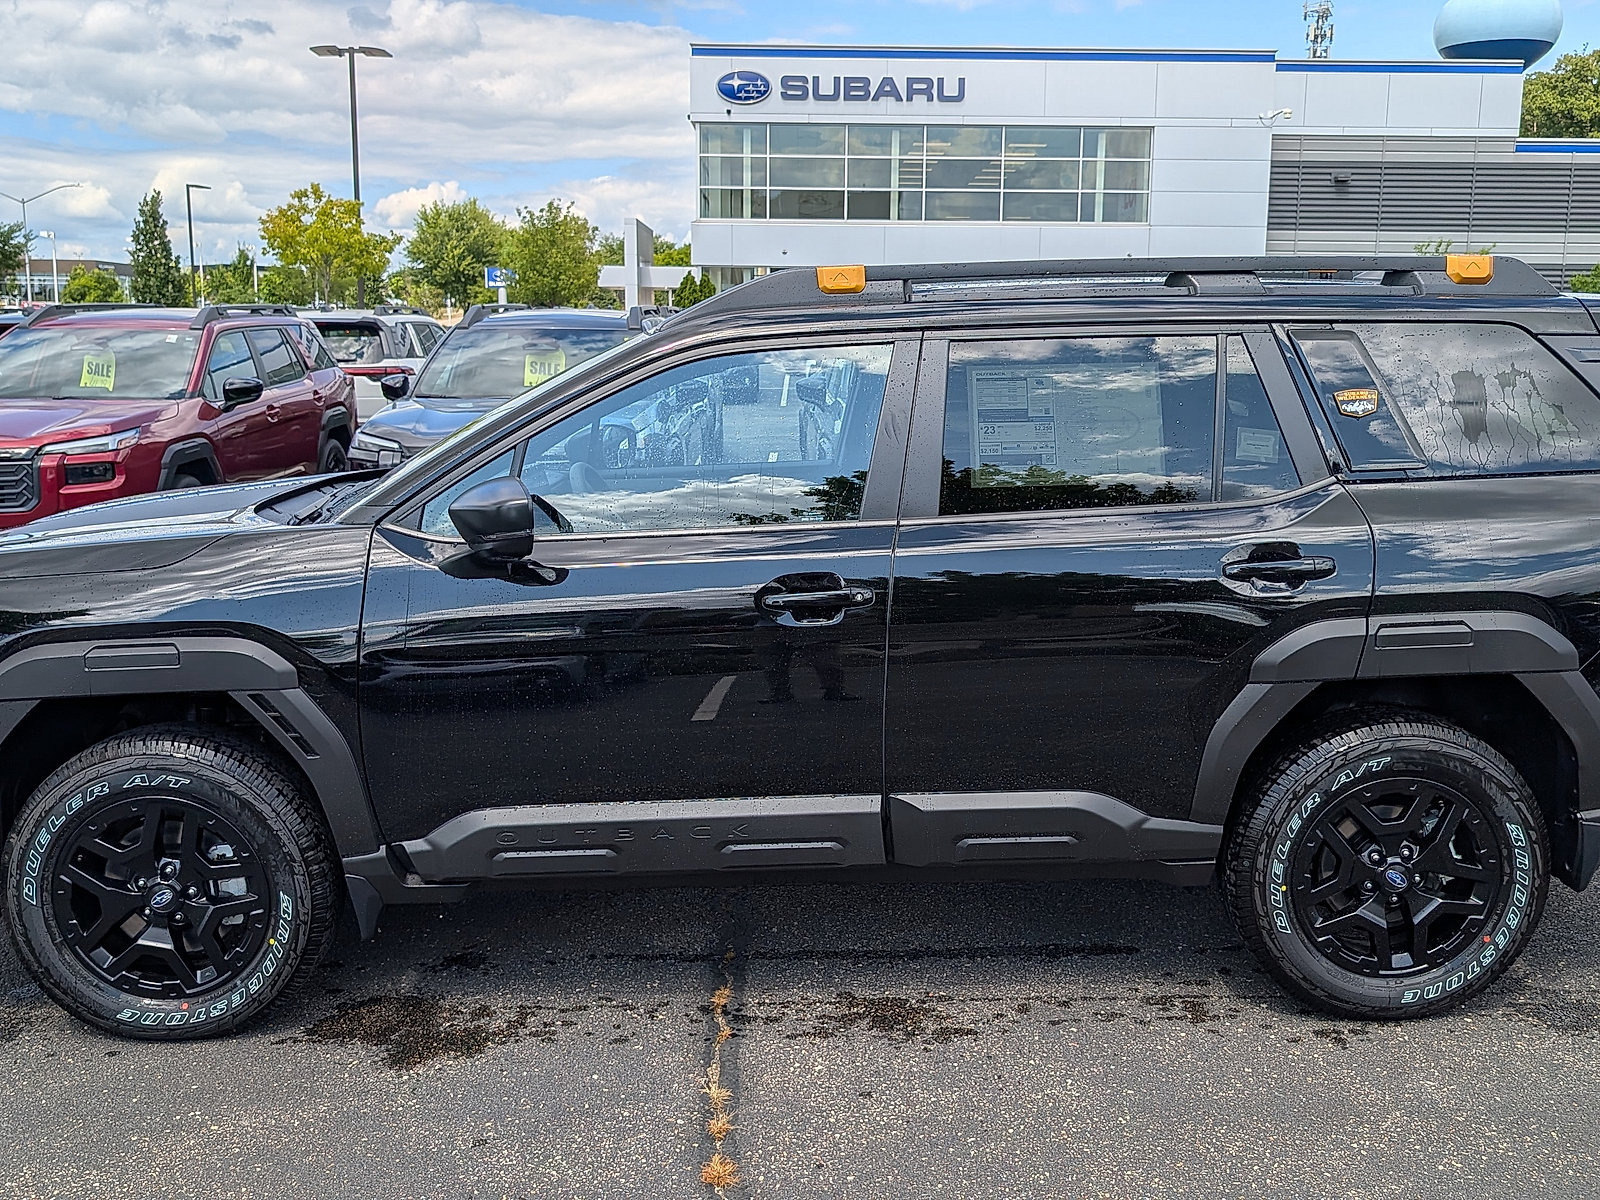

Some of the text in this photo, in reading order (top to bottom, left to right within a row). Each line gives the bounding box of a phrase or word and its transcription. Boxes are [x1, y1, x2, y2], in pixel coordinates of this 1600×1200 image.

[780, 75, 966, 102] SUBARU
[87, 361, 112, 378] SALE
[529, 361, 560, 376] SALE
[983, 425, 996, 435] 23
[22, 773, 191, 905] DUELER A/T
[495, 823, 750, 846] OUTBACK
[1269, 757, 1391, 934] DUELER A/T
[1400, 822, 1530, 1004] BRIDGESTONE
[115, 890, 293, 1026] BRIDGESTONE
